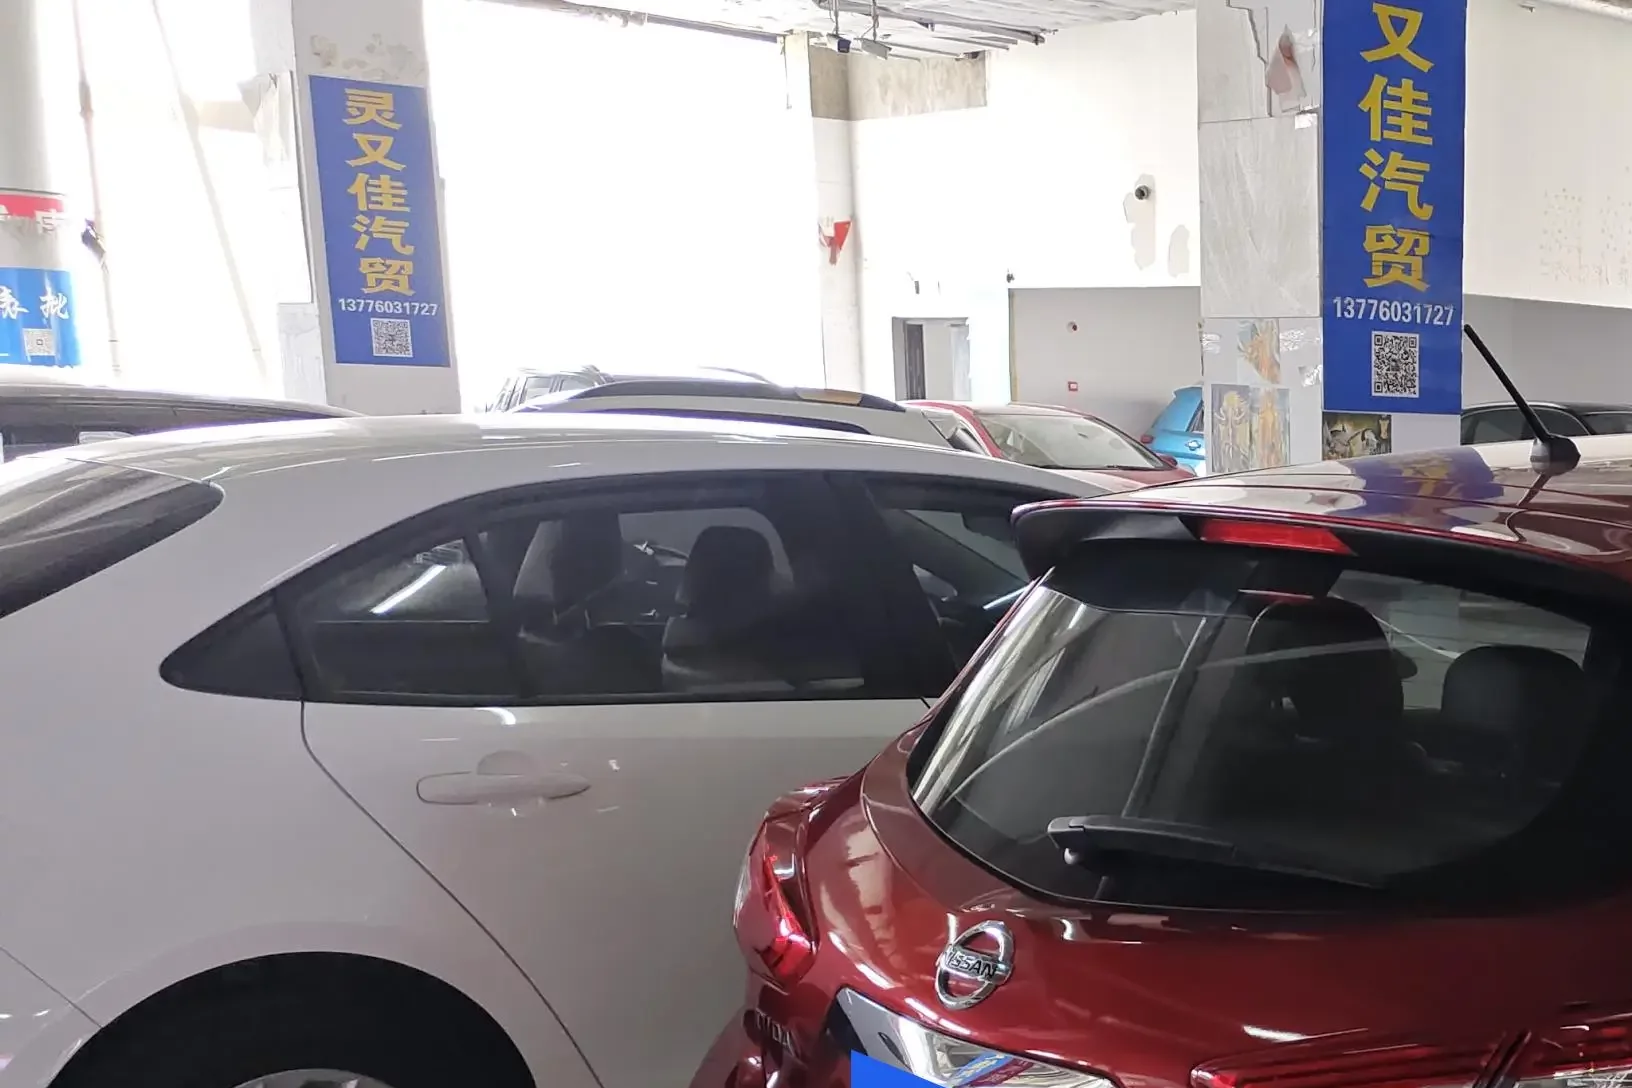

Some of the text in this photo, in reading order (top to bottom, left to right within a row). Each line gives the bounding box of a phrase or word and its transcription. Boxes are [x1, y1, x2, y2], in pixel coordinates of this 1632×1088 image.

[342, 88, 416, 297] 灵又佳汽贸
[1358, 2, 1434, 292] 又佳汽贸
[338, 298, 438, 316] 13776031727
[1332, 296, 1454, 326] 13776031727
